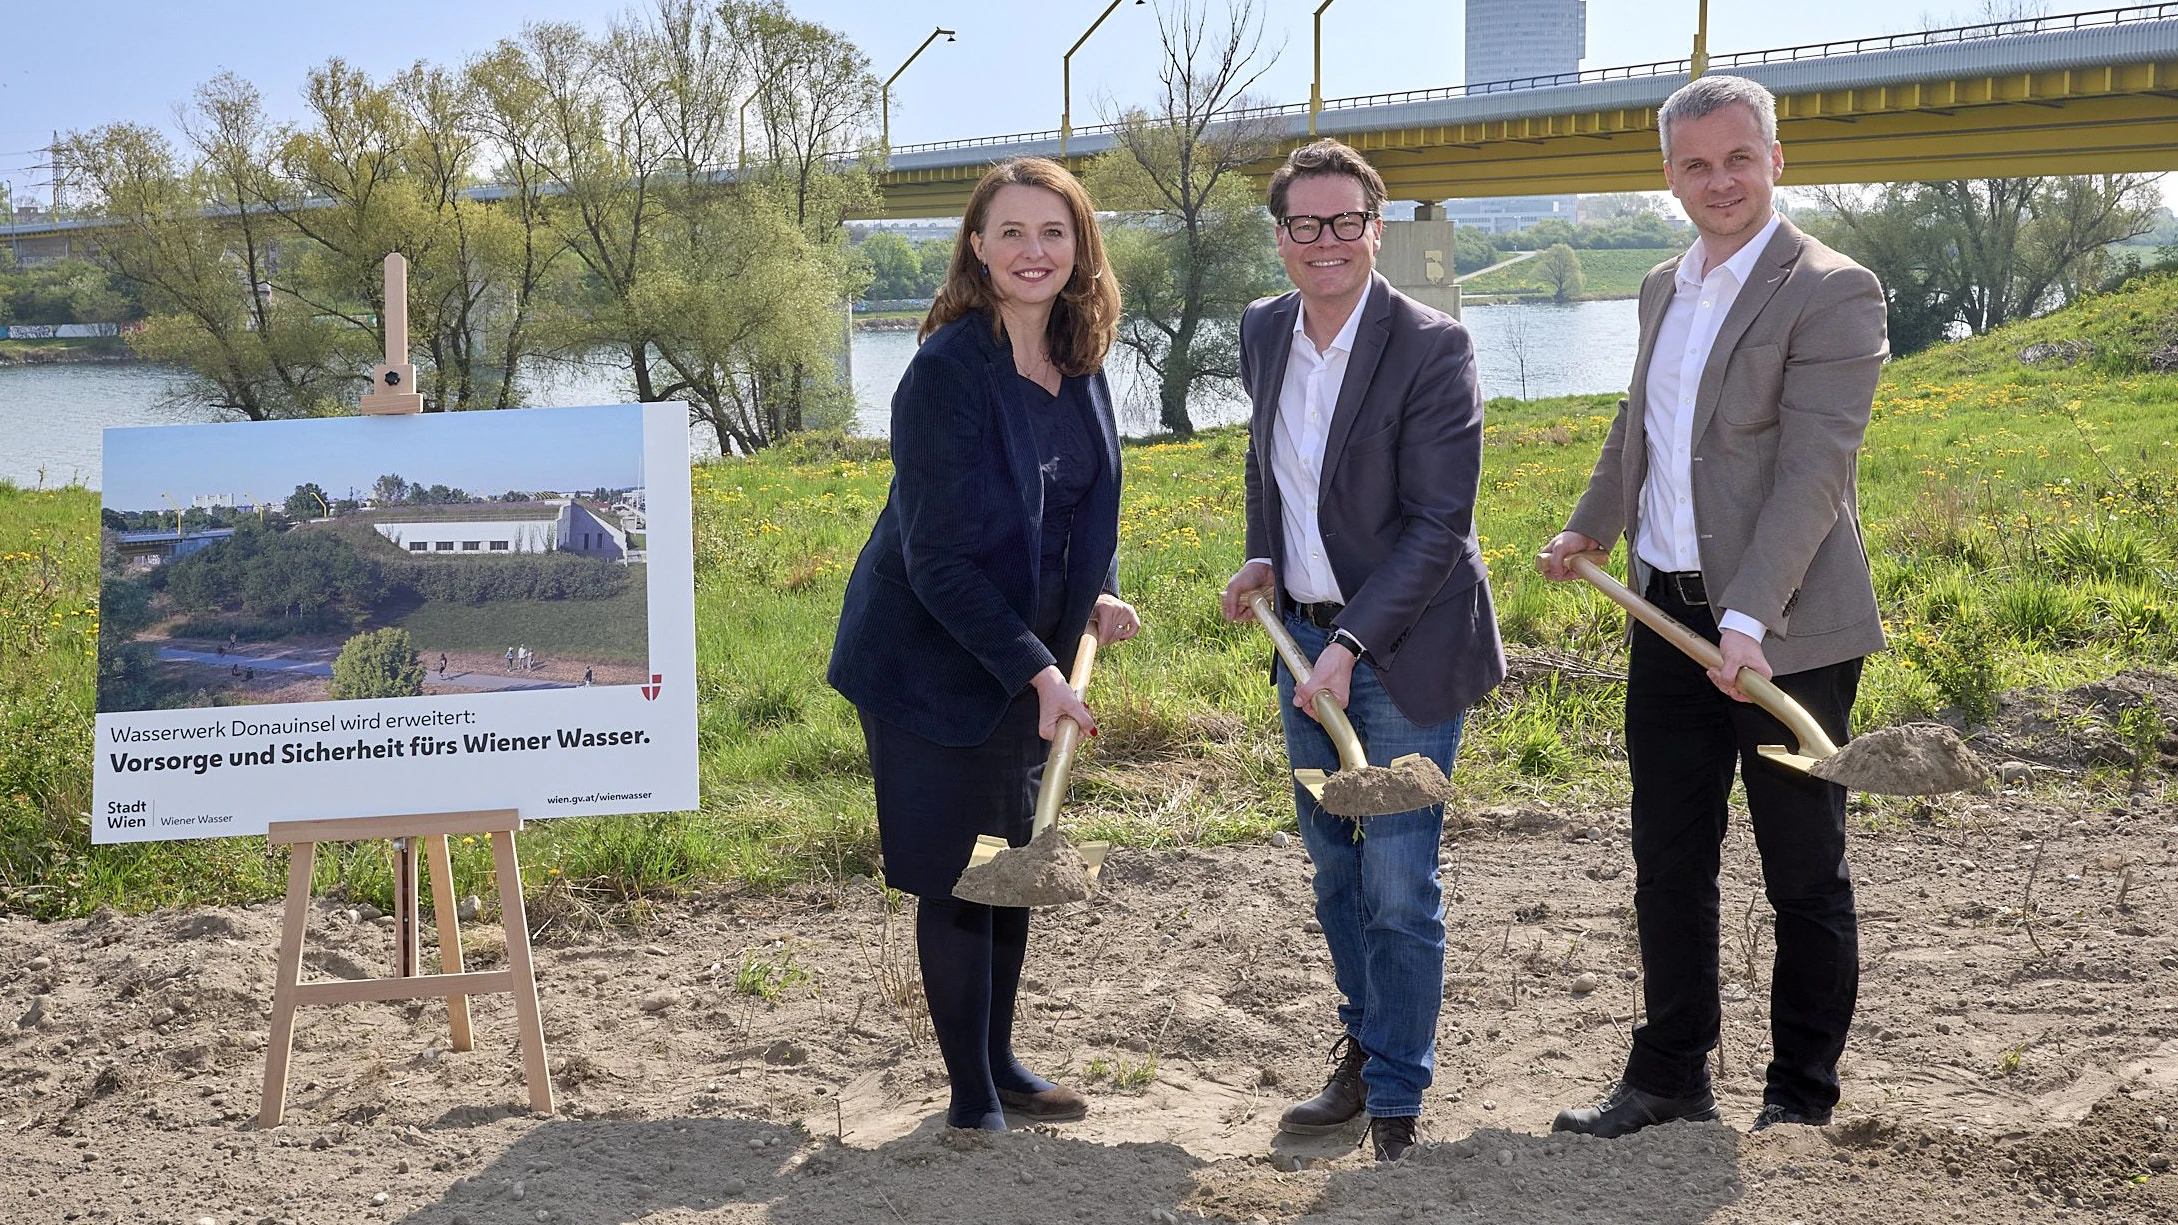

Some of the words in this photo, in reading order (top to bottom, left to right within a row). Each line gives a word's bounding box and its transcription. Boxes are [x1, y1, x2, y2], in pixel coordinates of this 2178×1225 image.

[110, 721, 226, 743] Wasserwerk
[231, 714, 335, 737] Donauinsel
[340, 712, 380, 731] wird
[386, 710, 476, 729] erweitert:
[110, 752, 223, 775] Vorsorge
[229, 744, 275, 767] und
[281, 737, 404, 764] Sicherheit
[409, 736, 458, 757] fürs
[463, 732, 551, 753] Wiener
[556, 727, 651, 748] Wasser.
[547, 791, 653, 805] wien.gv.at/wienwasser
[107, 800, 147, 814] Stadt
[107, 815, 146, 829] Wien
[160, 815, 196, 826] Wiener
[197, 814, 233, 824] Wasser
